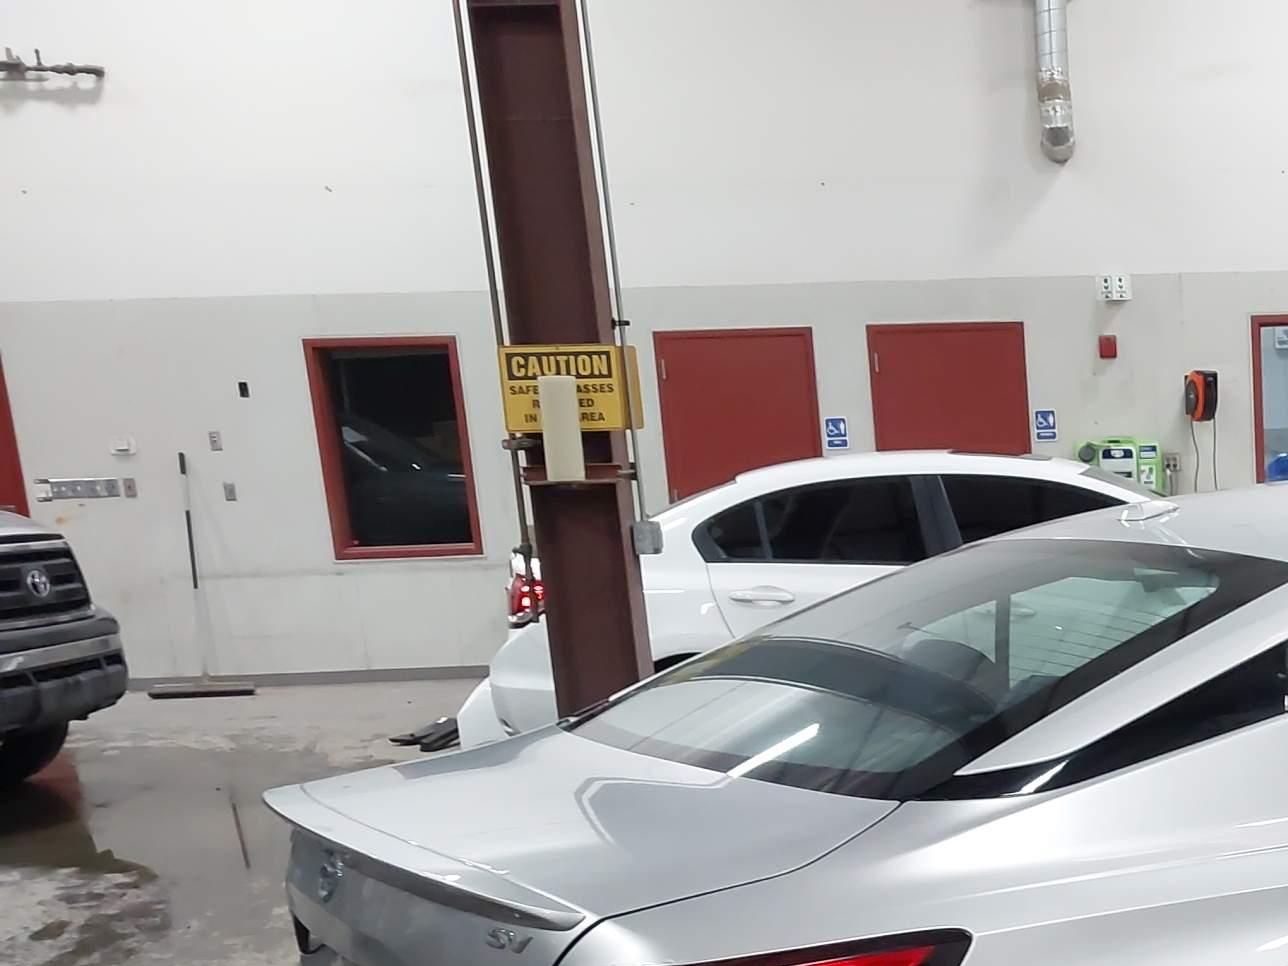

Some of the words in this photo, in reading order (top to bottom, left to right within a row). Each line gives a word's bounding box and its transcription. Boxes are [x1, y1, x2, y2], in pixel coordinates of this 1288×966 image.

[511, 354, 609, 377] CAUTION
[509, 385, 539, 395] SAFE
[577, 383, 614, 393] ASSES
[579, 412, 605, 422] REA
[486, 927, 533, 954] SV
